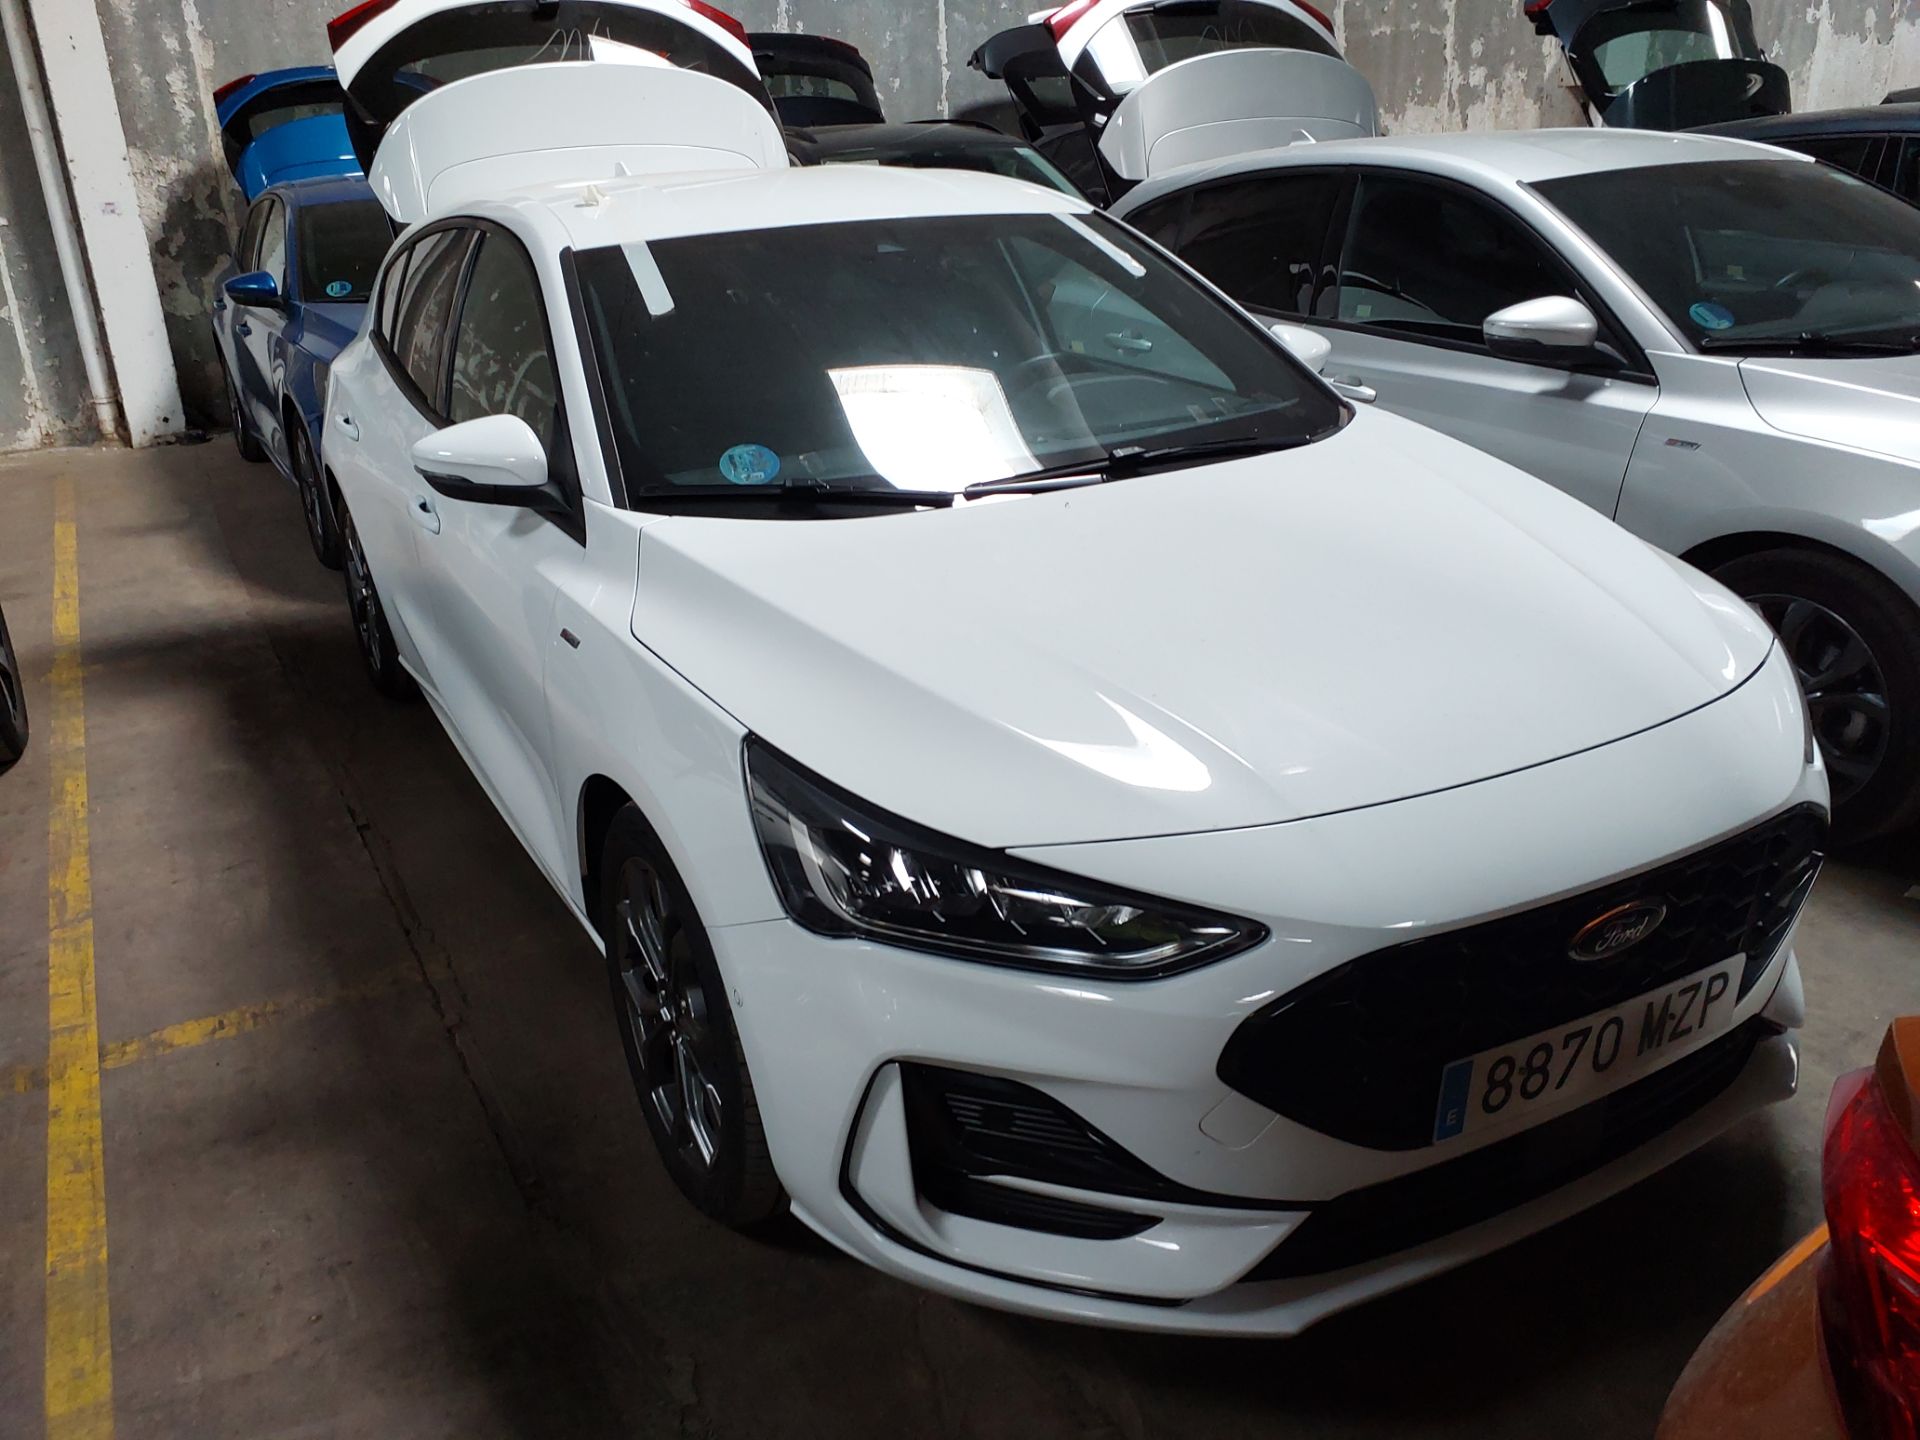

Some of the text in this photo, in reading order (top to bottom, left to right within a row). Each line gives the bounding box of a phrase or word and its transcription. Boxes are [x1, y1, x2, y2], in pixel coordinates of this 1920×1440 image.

[1595, 916, 1648, 951] Ford
[1482, 972, 1730, 1114] 8870 MZP
[1446, 1109, 1457, 1125] E
